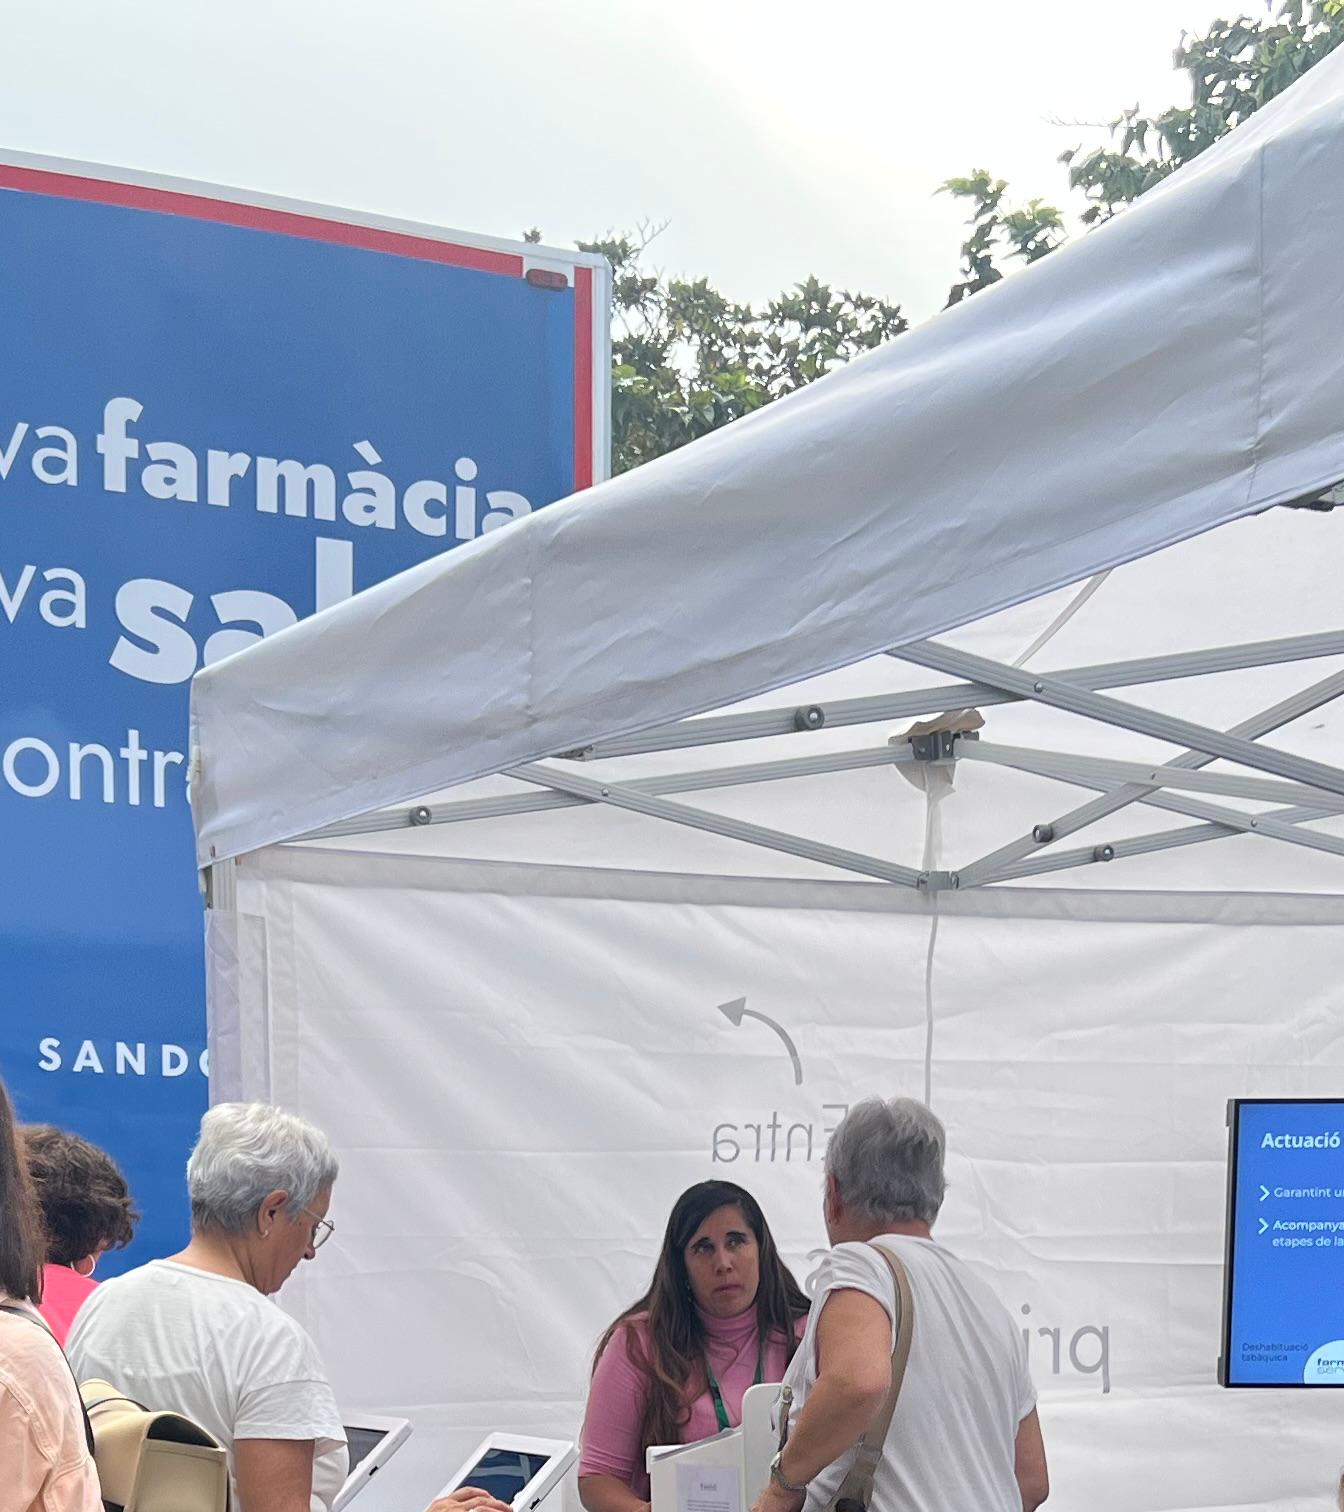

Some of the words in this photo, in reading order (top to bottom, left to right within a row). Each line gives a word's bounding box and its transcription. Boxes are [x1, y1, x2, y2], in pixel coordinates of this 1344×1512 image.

[38, 1037, 209, 1077] SAND
[1261, 1131, 1341, 1149] Actuació
[1273, 1187, 1331, 1199] Garantint
[1272, 1237, 1313, 1249] etapes
[1315, 1236, 1331, 1248] de
[1334, 1236, 1344, 1247] la
